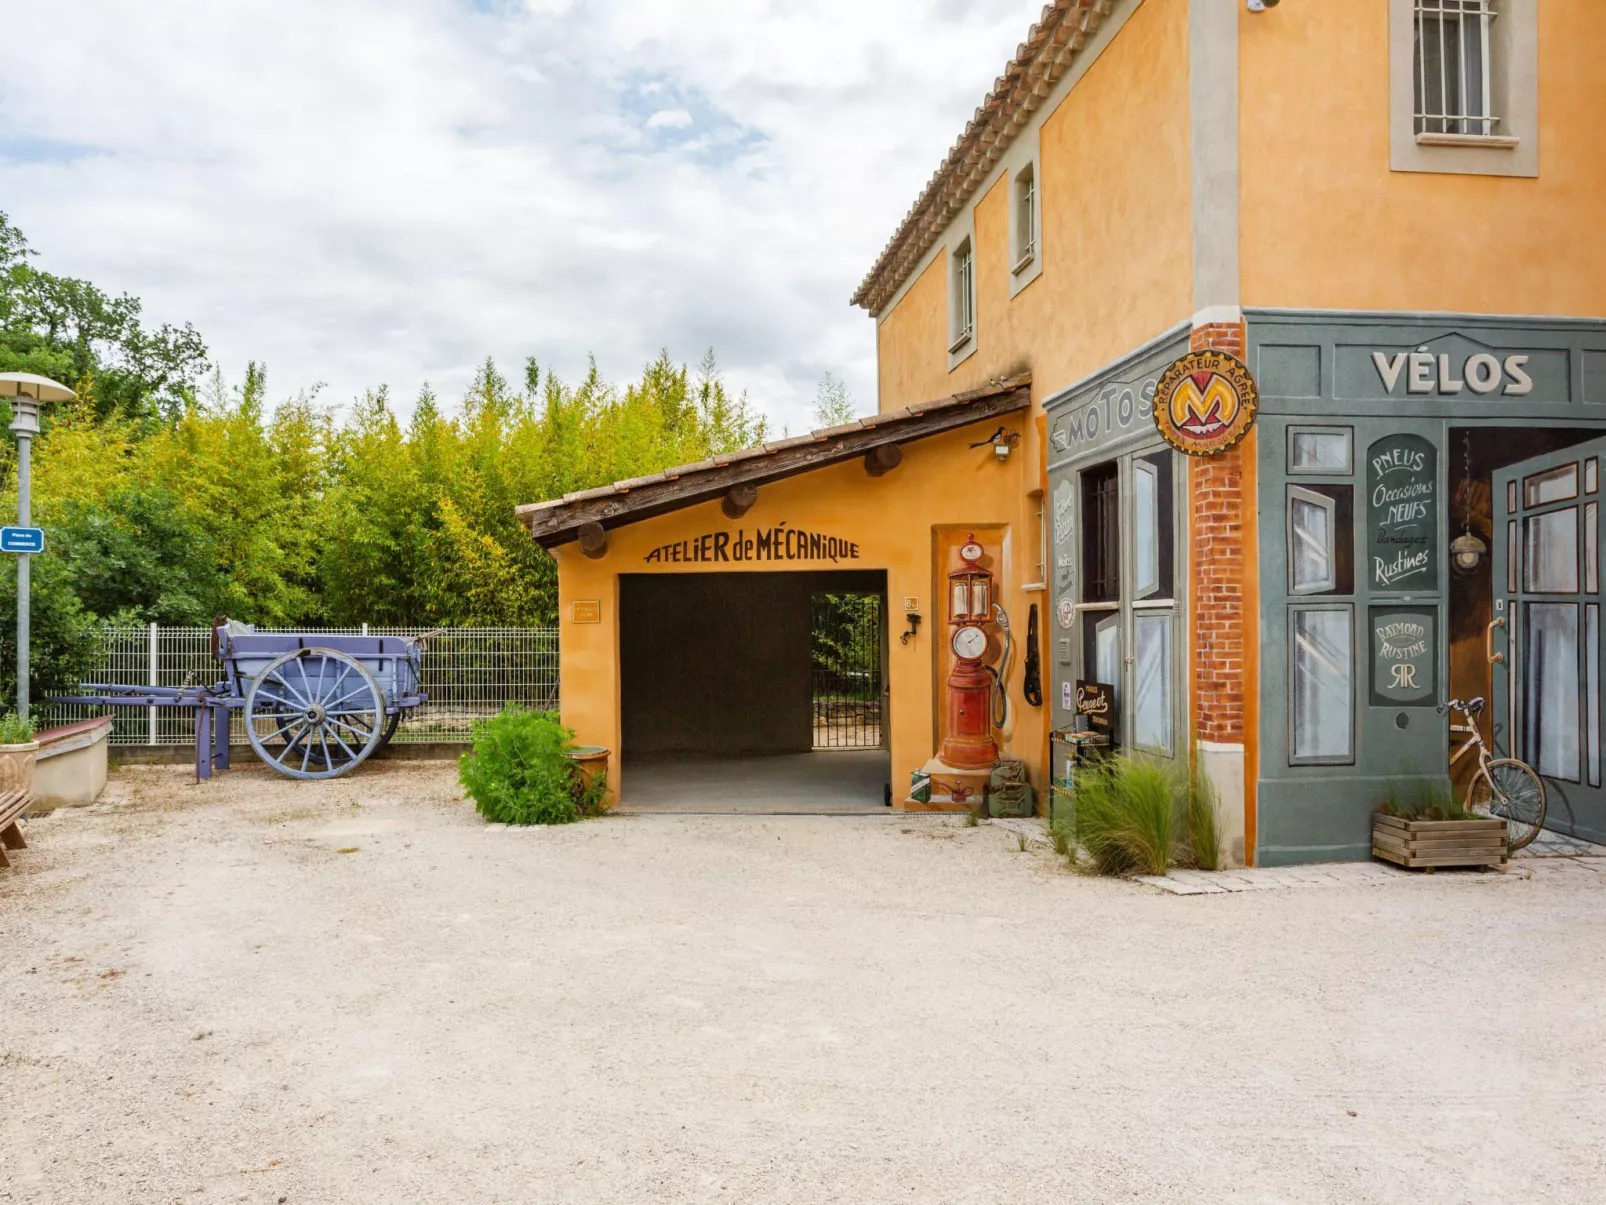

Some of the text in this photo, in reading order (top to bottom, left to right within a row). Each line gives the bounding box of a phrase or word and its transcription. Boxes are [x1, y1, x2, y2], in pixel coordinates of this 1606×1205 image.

[1371, 346, 1534, 396] VÉLOS
[1067, 378, 1156, 449] MOTOS
[1372, 449, 1425, 480] PNEUS
[1379, 500, 1431, 526] NEUFS
[1374, 550, 1429, 585] Rustines
[1376, 622, 1425, 642] RAYMOND
[1378, 640, 1428, 660] RUSTINE
